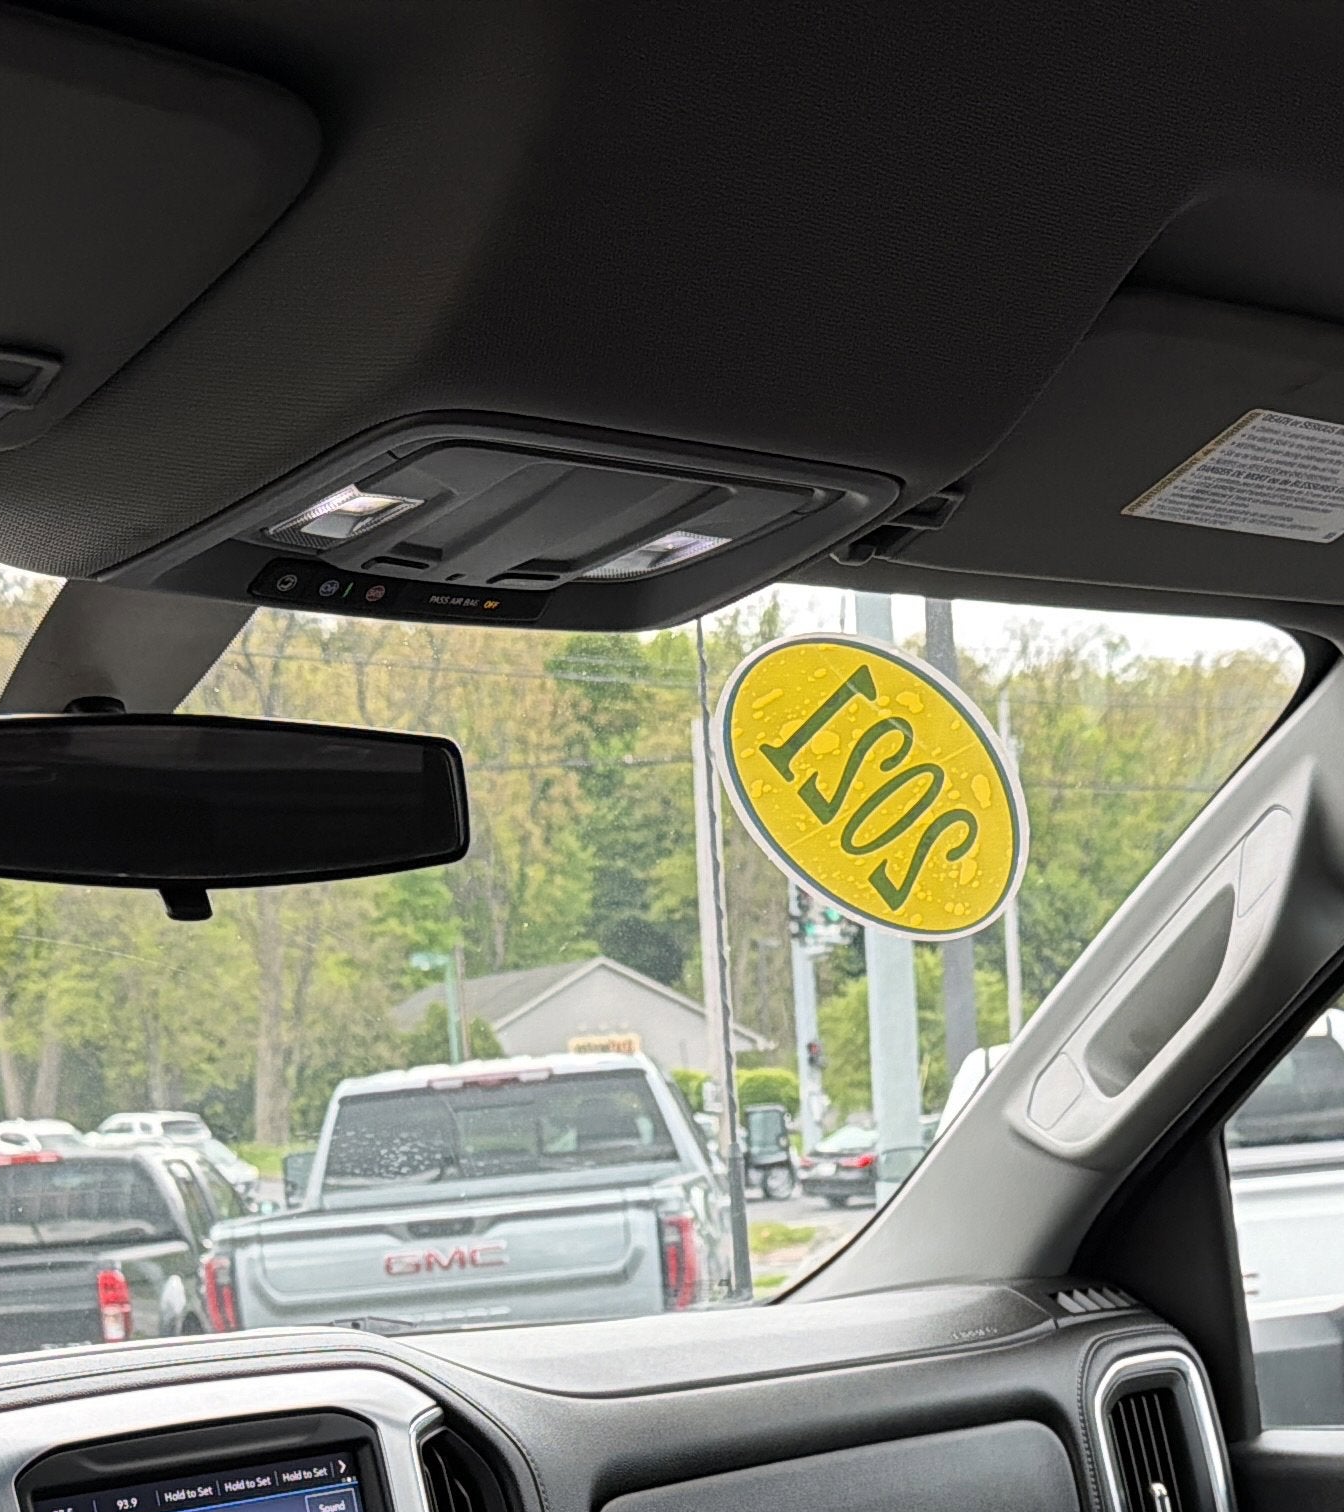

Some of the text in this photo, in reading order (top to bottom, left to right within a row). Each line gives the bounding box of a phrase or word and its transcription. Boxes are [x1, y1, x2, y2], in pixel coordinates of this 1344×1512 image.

[429, 596, 500, 609] PASS AIR BAG OFF
[384, 1239, 509, 1277] GMC
[282, 1467, 329, 1482] Hold to Set
[224, 1476, 272, 1492] Hold to Set
[164, 1486, 214, 1502] Hold to Set
[116, 1497, 138, 1511] 93.9
